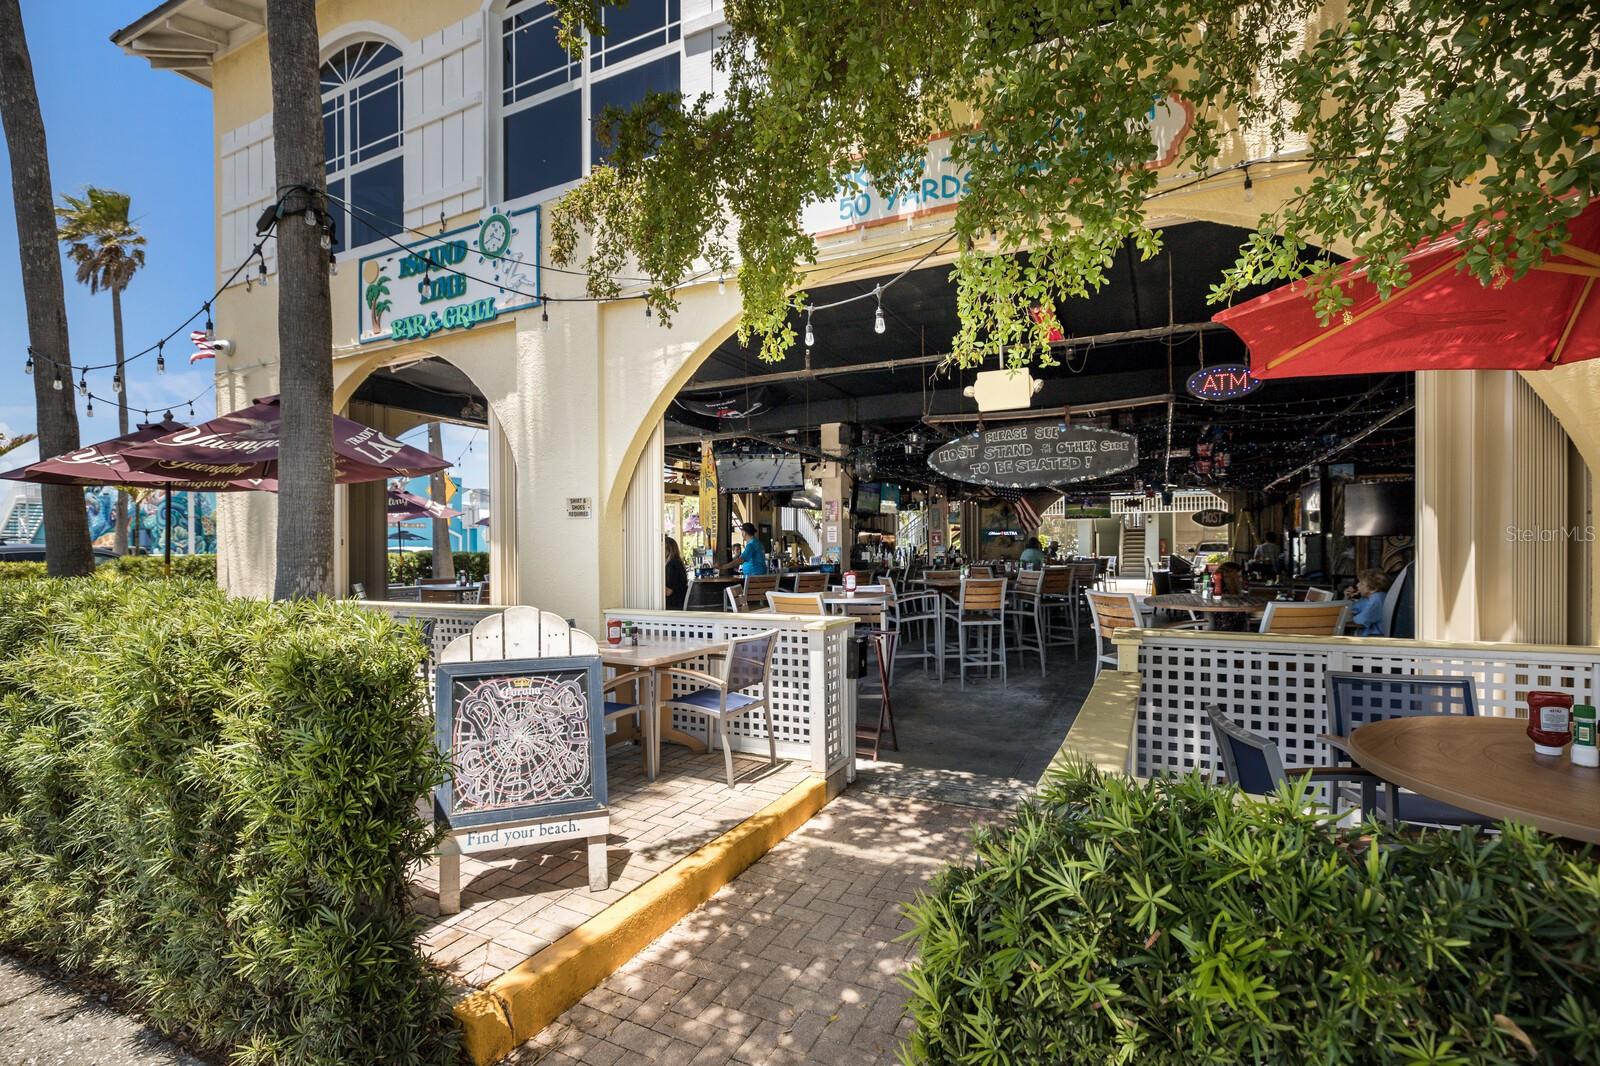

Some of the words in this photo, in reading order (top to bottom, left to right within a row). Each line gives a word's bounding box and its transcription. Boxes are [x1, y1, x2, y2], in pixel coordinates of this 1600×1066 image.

[839, 192, 871, 221] 50
[399, 240, 468, 279] ISLAND
[391, 314, 431, 339] BAR
[427, 312, 443, 333] &
[442, 297, 498, 330] GRILL
[1203, 372, 1248, 391] ATM
[985, 427, 1028, 443] PLEASE
[1035, 426, 1060, 439] SEE
[939, 445, 979, 463] HOST
[984, 444, 1033, 459] STAND
[1056, 440, 1097, 453] OTHER
[1100, 440, 1130, 452] SIDE
[970, 463, 990, 475] TO
[996, 460, 1013, 474] BE
[1017, 457, 1081, 473] SEATED
[1202, 511, 1223, 524] HOST
[500, 686, 542, 699] Corona
[467, 831, 499, 846] Find
[504, 827, 535, 846] your
[539, 819, 581, 837] beach.
